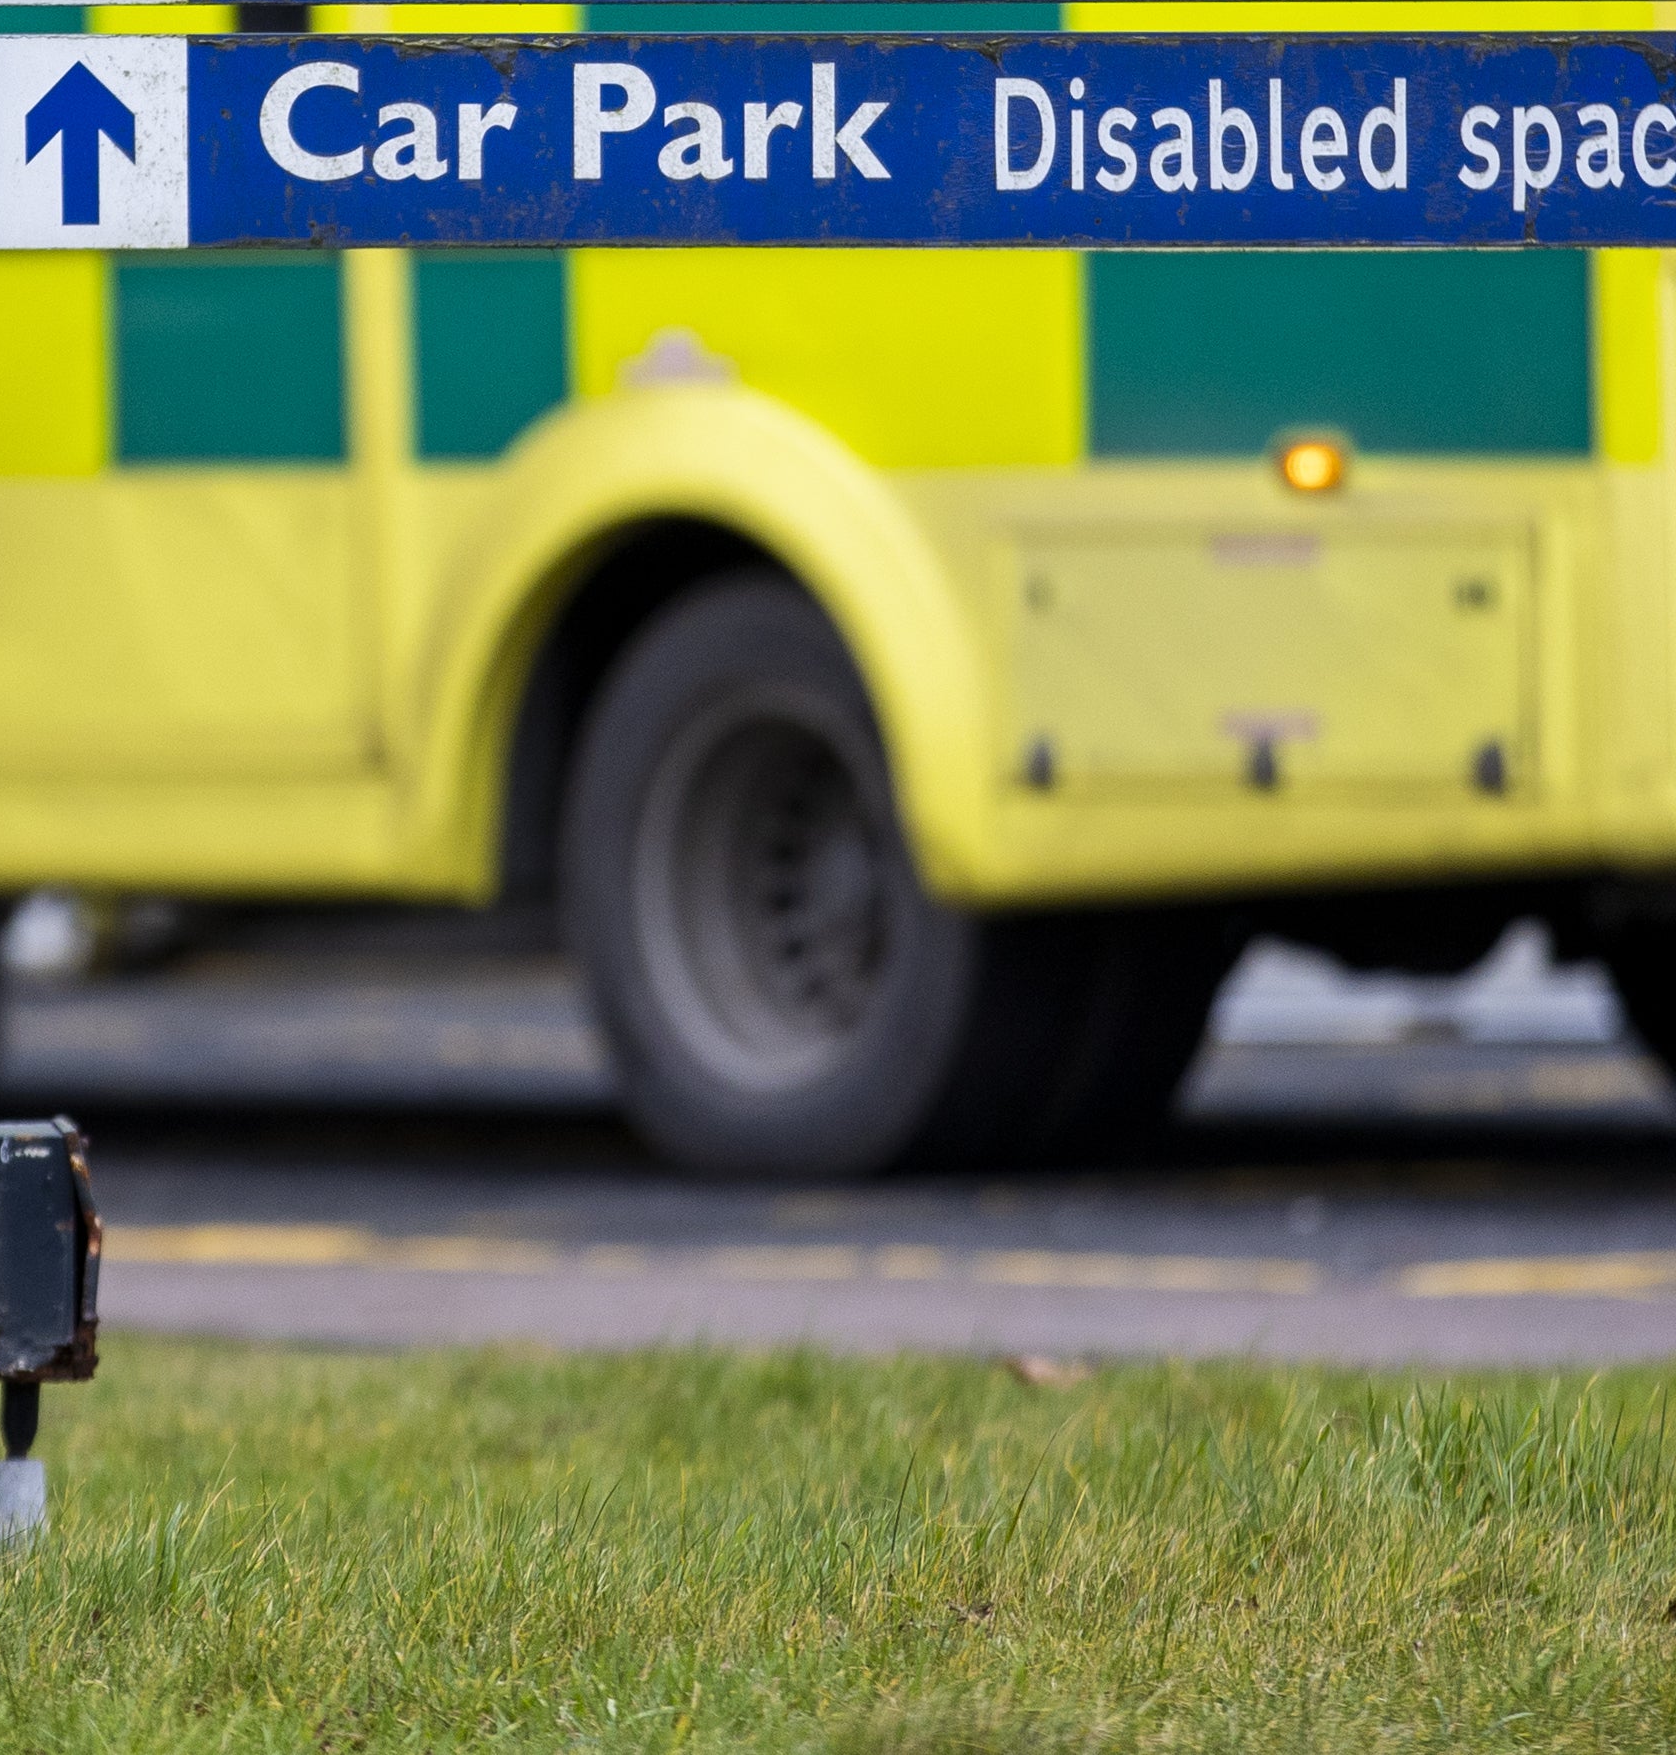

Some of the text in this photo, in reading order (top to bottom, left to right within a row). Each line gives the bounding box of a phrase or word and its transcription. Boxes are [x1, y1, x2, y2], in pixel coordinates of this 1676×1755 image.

[260, 62, 517, 181] Car
[574, 63, 891, 180] Park
[995, 78, 1407, 192] Disabled
